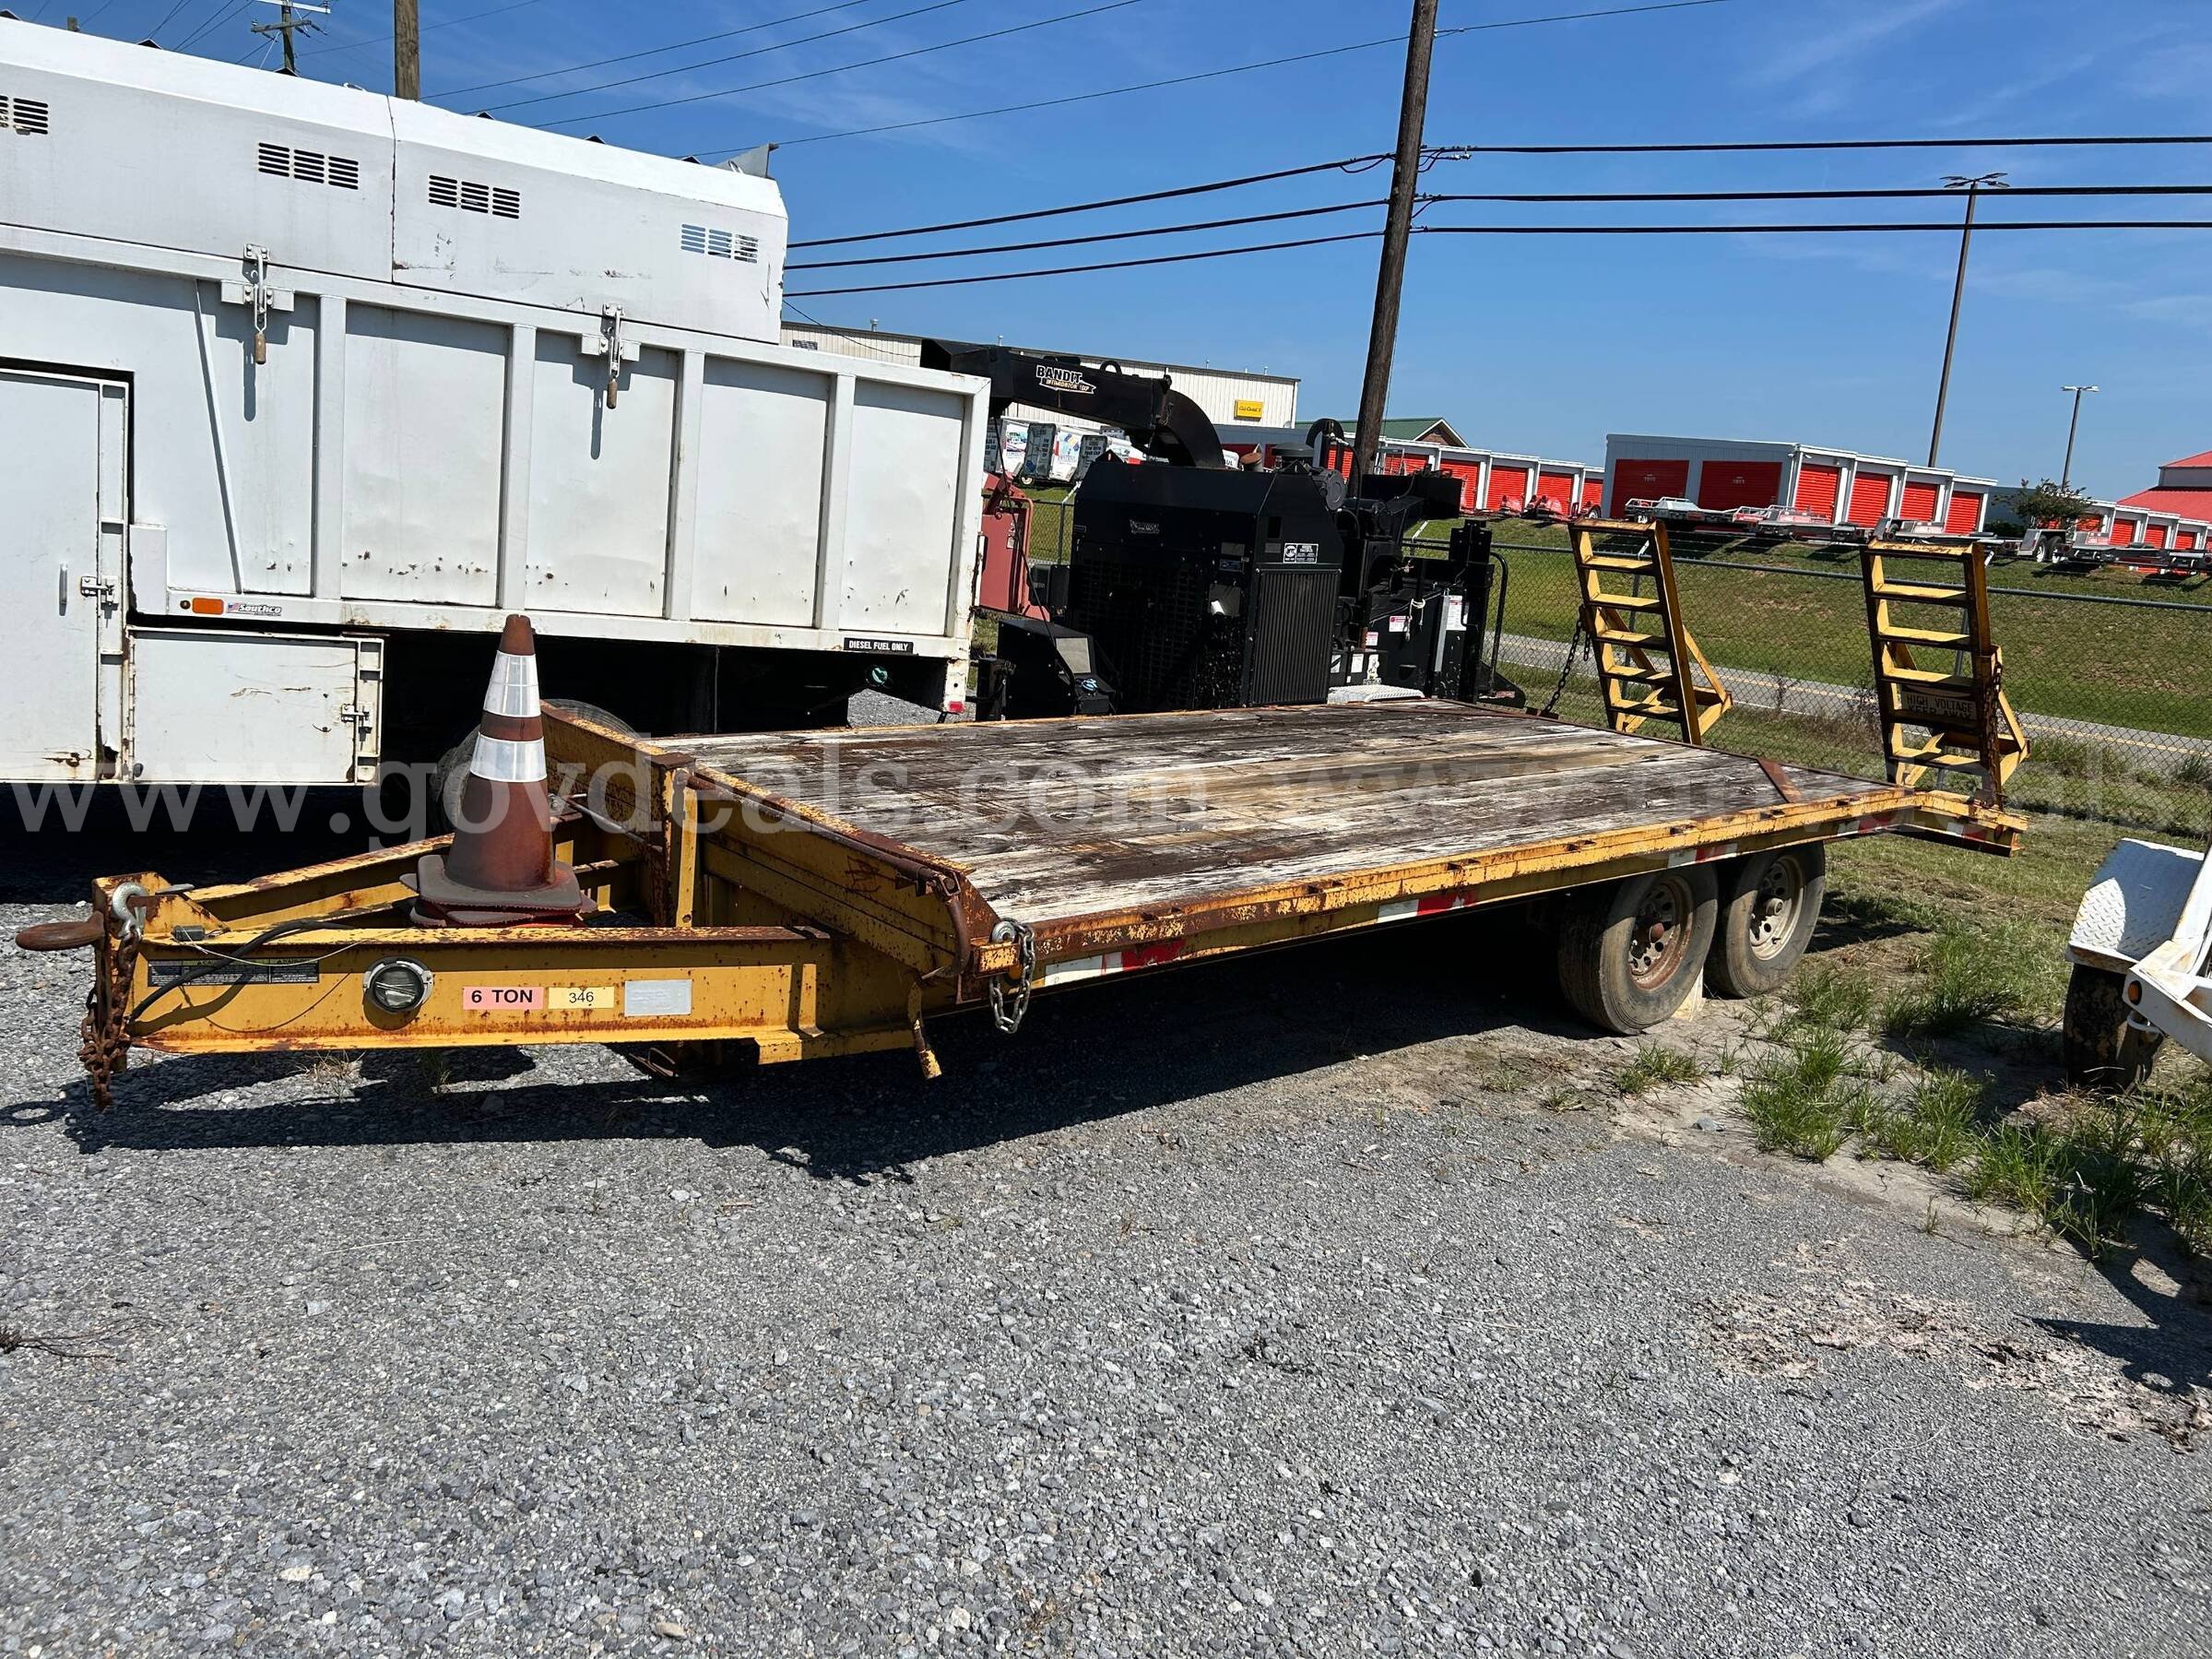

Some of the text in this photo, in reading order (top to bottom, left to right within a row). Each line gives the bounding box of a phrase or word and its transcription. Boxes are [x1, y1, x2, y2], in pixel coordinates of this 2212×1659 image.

[1035, 364, 1083, 385] BANDIT
[238, 603, 282, 614] Southco
[848, 640, 909, 652] DIESEL FUEL ONLY
[1906, 693, 1973, 713] HIGH VOLTAGE
[471, 989, 595, 1004] 6 TON 346
